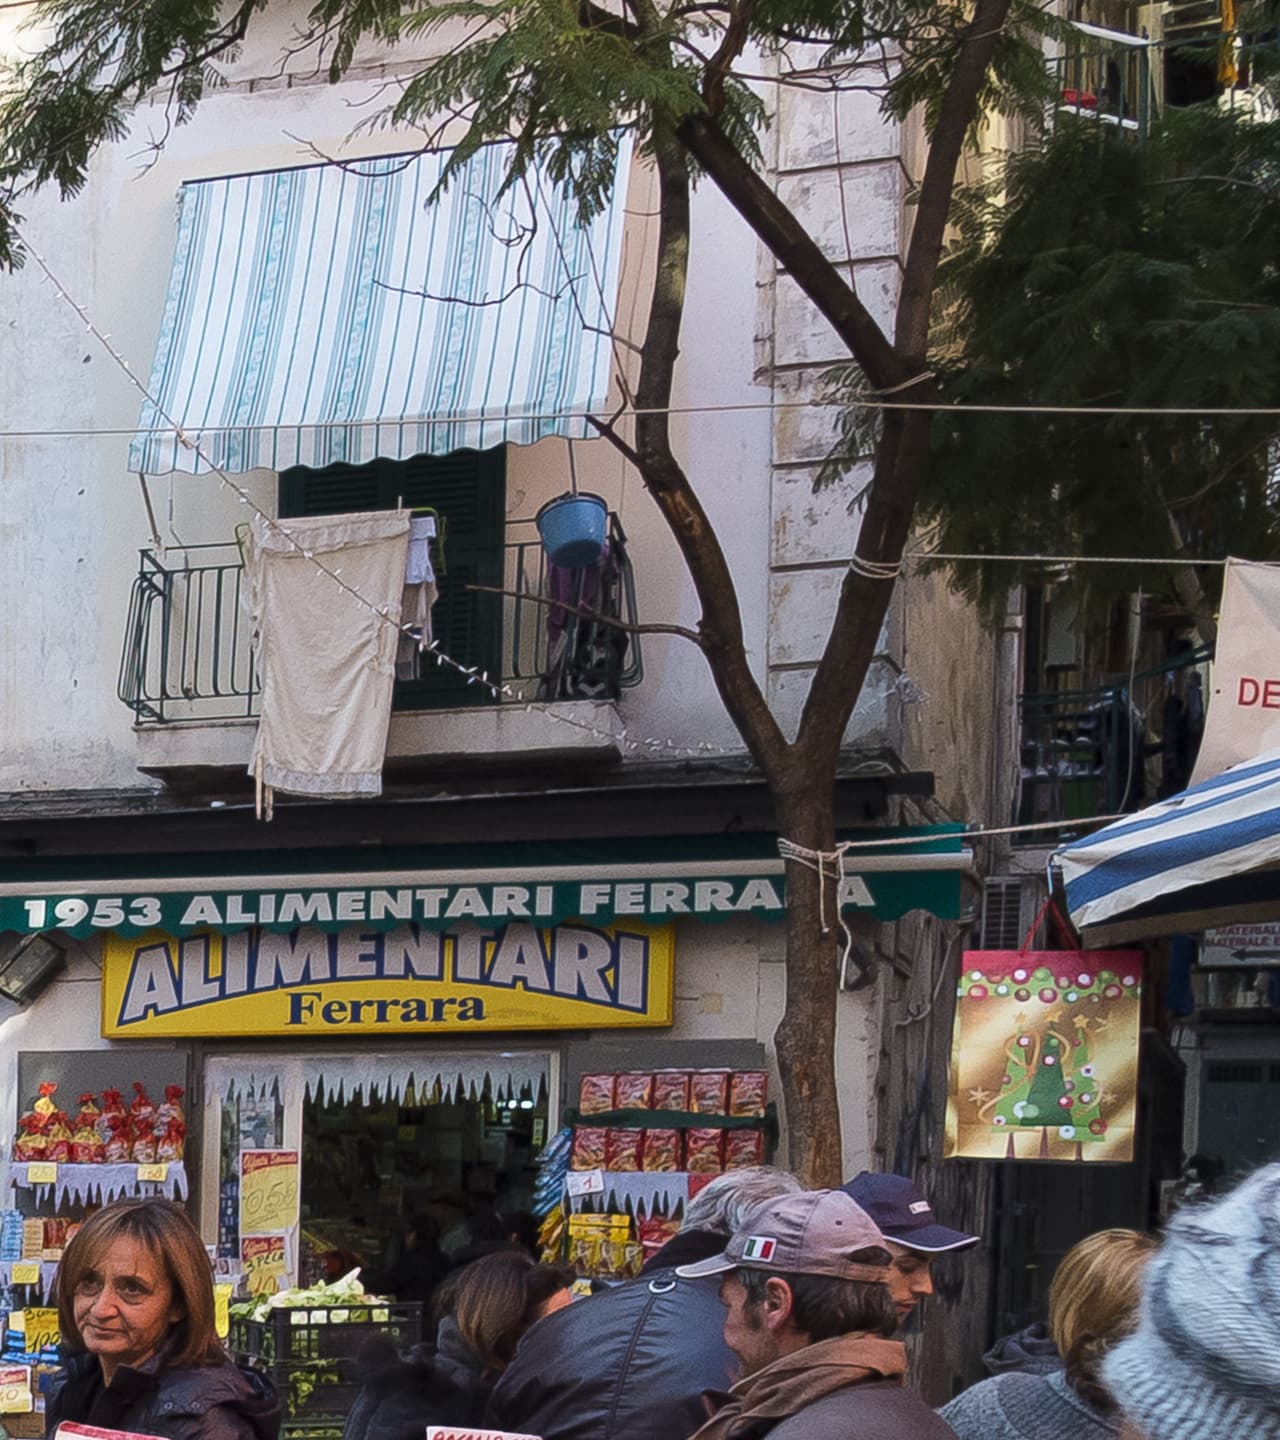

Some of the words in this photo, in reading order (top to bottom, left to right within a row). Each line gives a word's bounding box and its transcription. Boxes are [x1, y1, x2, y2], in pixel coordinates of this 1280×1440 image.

[24, 896, 162, 929] 1953
[181, 884, 555, 926] ALIMENTARI
[580, 876, 875, 915] FERRAA
[116, 920, 648, 1028] ALIMENTARI
[285, 991, 486, 1026] Ferrara
